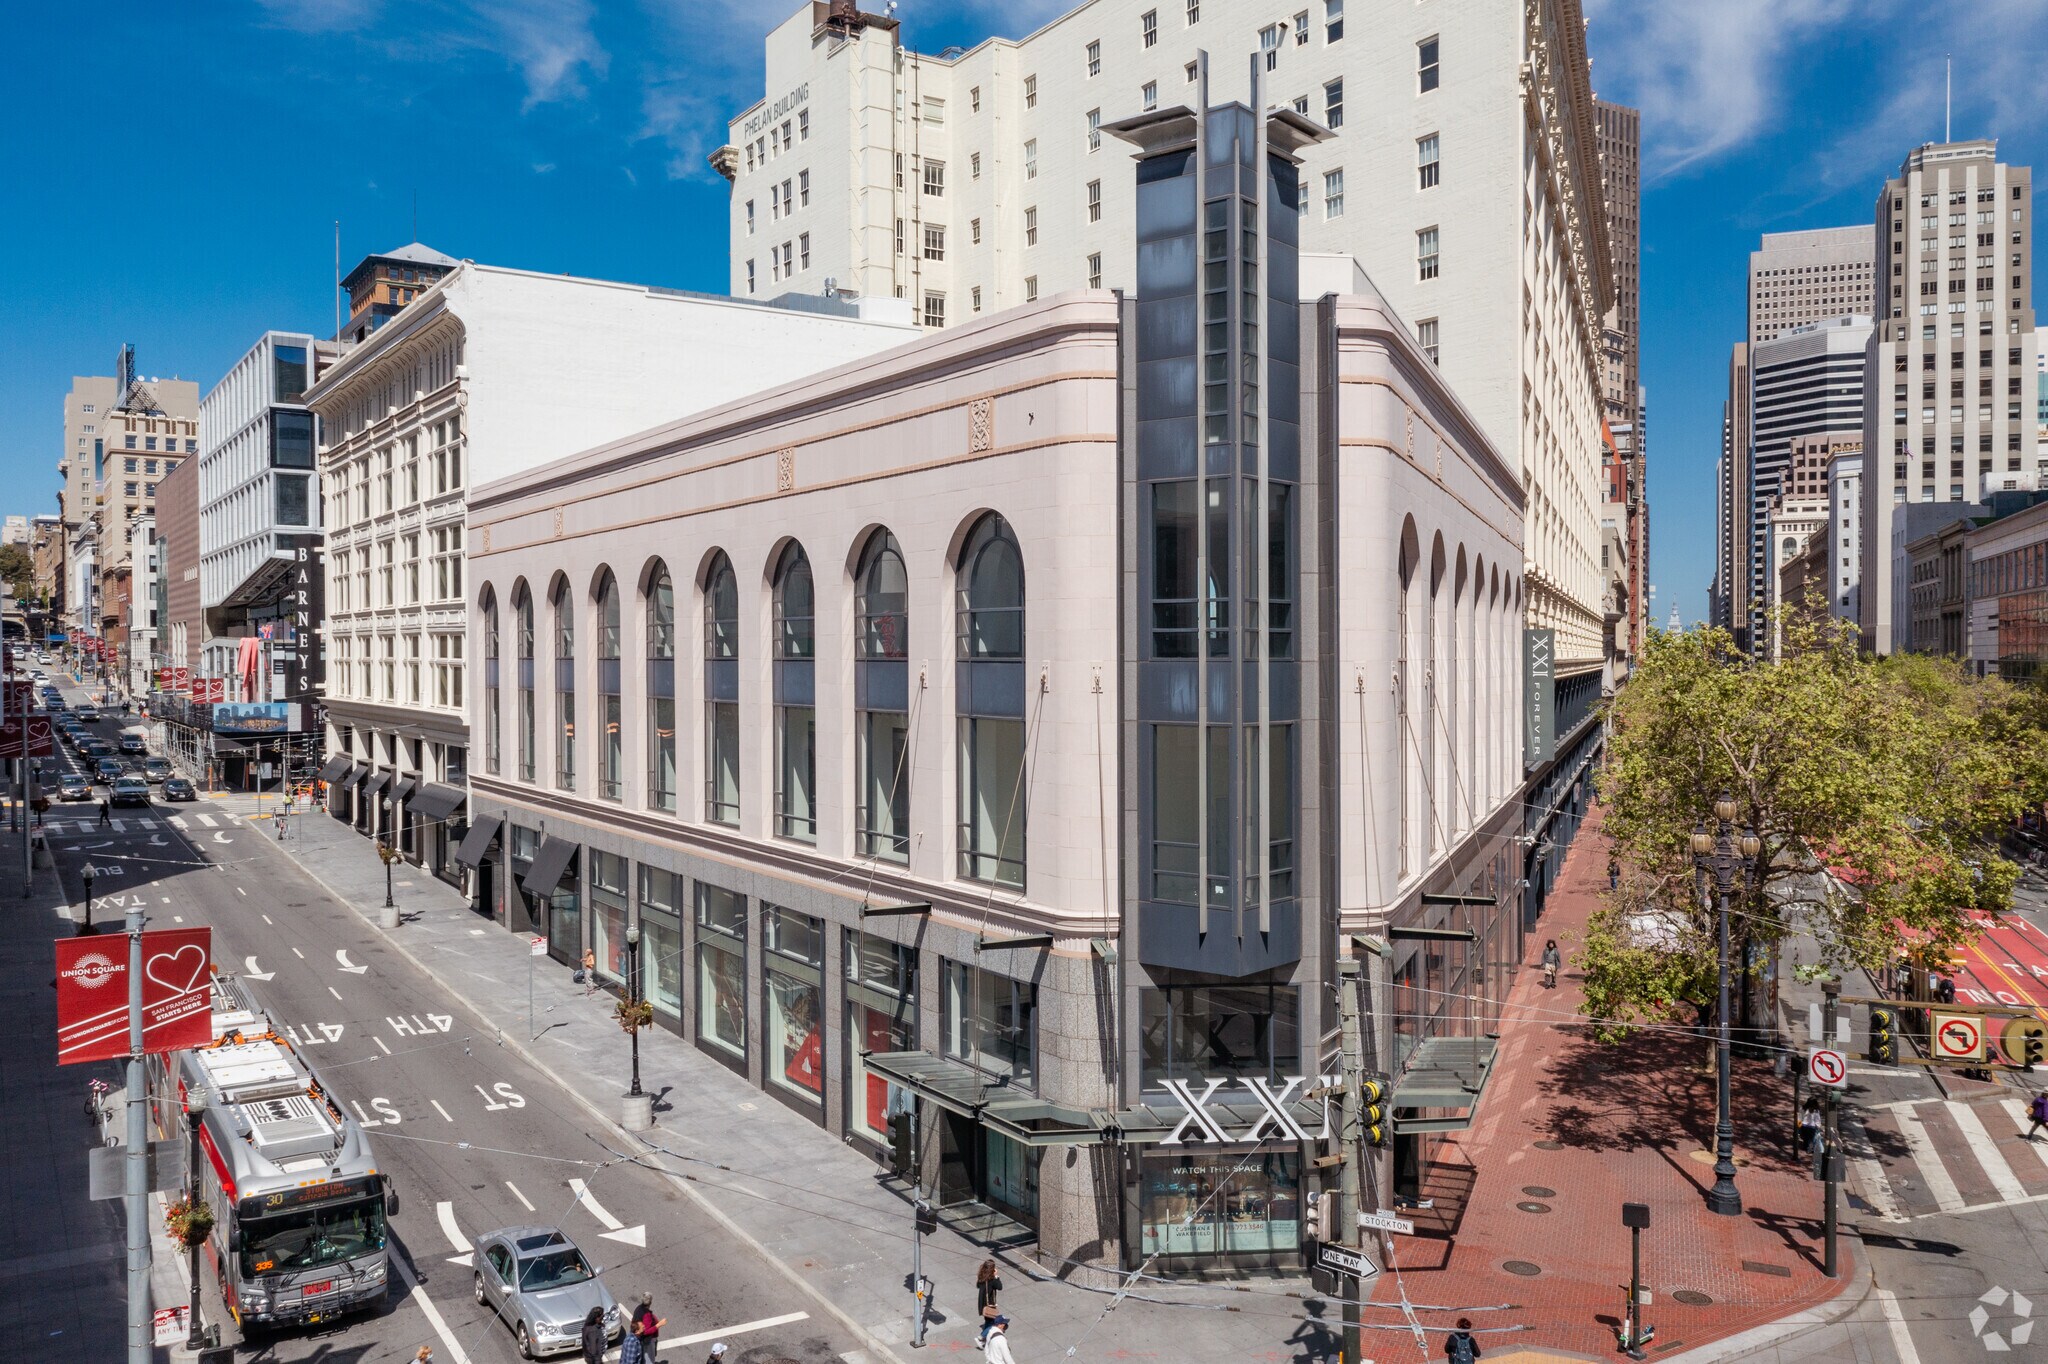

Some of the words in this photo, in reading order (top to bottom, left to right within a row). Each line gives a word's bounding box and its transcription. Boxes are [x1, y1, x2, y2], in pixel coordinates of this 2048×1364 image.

[744, 107, 772, 139] PHELAN
[773, 82, 809, 121] BUILDING
[297, 547, 309, 692] BARNEYS
[1532, 635, 1548, 678] XXI
[80, 865, 124, 876] BU
[90, 895, 147, 909] TAX
[61, 967, 91, 978] UNION
[92, 964, 126, 975] SQUARE
[151, 1007, 165, 1017] SAN
[165, 994, 203, 1011] FRANCISCO
[1953, 988, 2019, 1005] ONL
[155, 1008, 182, 1022] STARTS
[182, 1000, 202, 1014] HERE
[386, 1013, 453, 1037] 4TH
[474, 1082, 526, 1111] ST
[351, 1097, 401, 1128] ST
[1210, 1165, 1230, 1173] THIS
[1233, 1164, 1262, 1173] SPACE
[266, 1193, 283, 1207] 30
[1365, 1216, 1408, 1231] STOCKTON
[255, 1260, 273, 1271] 335
[1323, 1249, 1341, 1263] ONE
[1343, 1256, 1360, 1268] WAY
[257, 1278, 275, 1286] 7241
